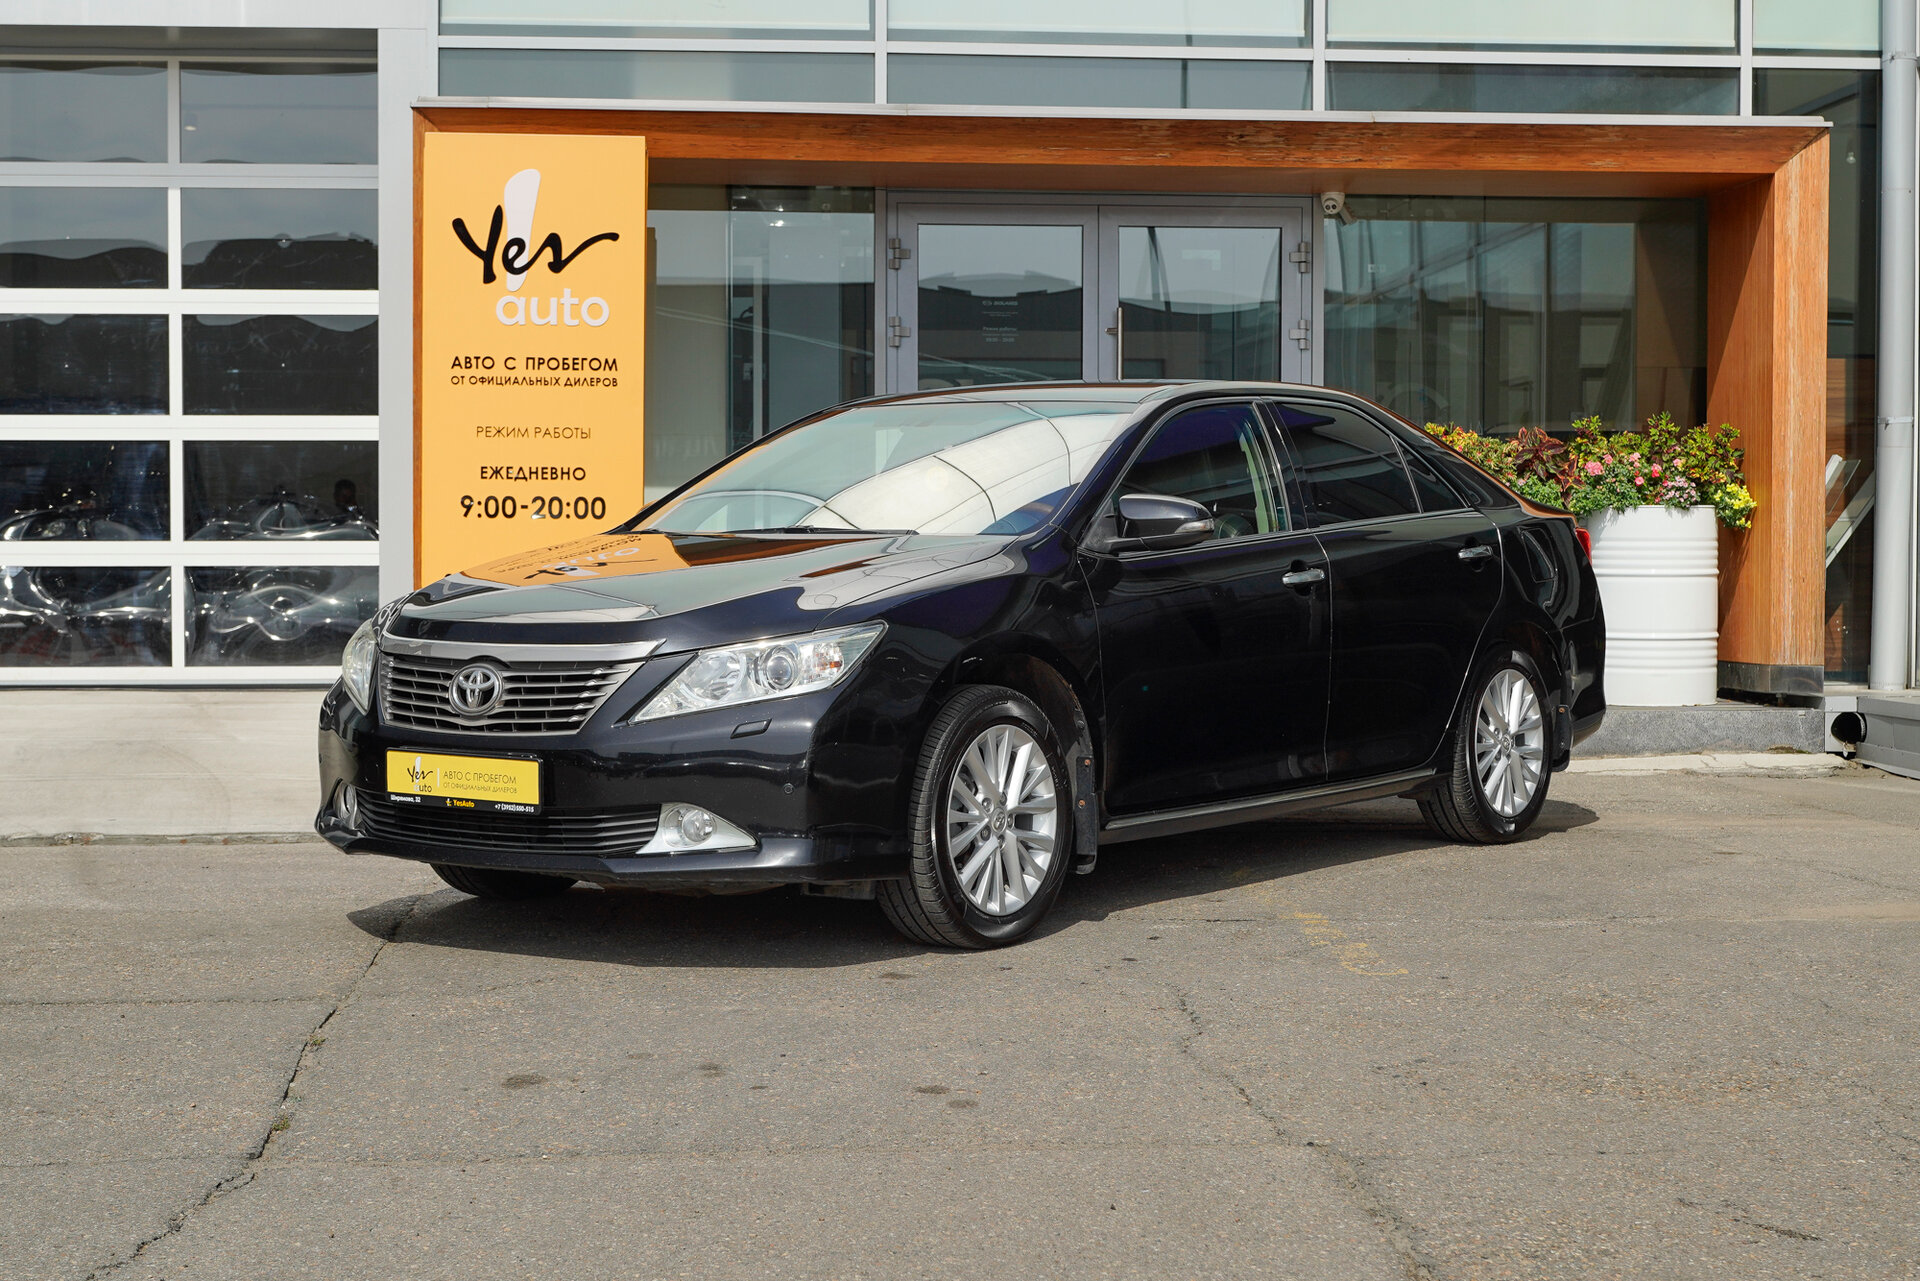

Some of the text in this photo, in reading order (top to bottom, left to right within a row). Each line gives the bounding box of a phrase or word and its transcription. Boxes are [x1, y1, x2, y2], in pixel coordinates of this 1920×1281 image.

[496, 288, 610, 326] auto
[451, 356, 618, 372] АВТО С ПРОБЕГОМ
[451, 375, 618, 388] ОТ ОФИЦИАЛЬНЫХ ДИЛЕРОВ
[476, 426, 591, 440] РЕЖИМ РАБОТЫ
[480, 466, 587, 482] ЕЖЕДНЕВНО
[460, 494, 607, 520] 9:00-20:00
[443, 771, 517, 784] АВТО С ПРОБЕГОМ
[414, 784, 432, 793] auto
